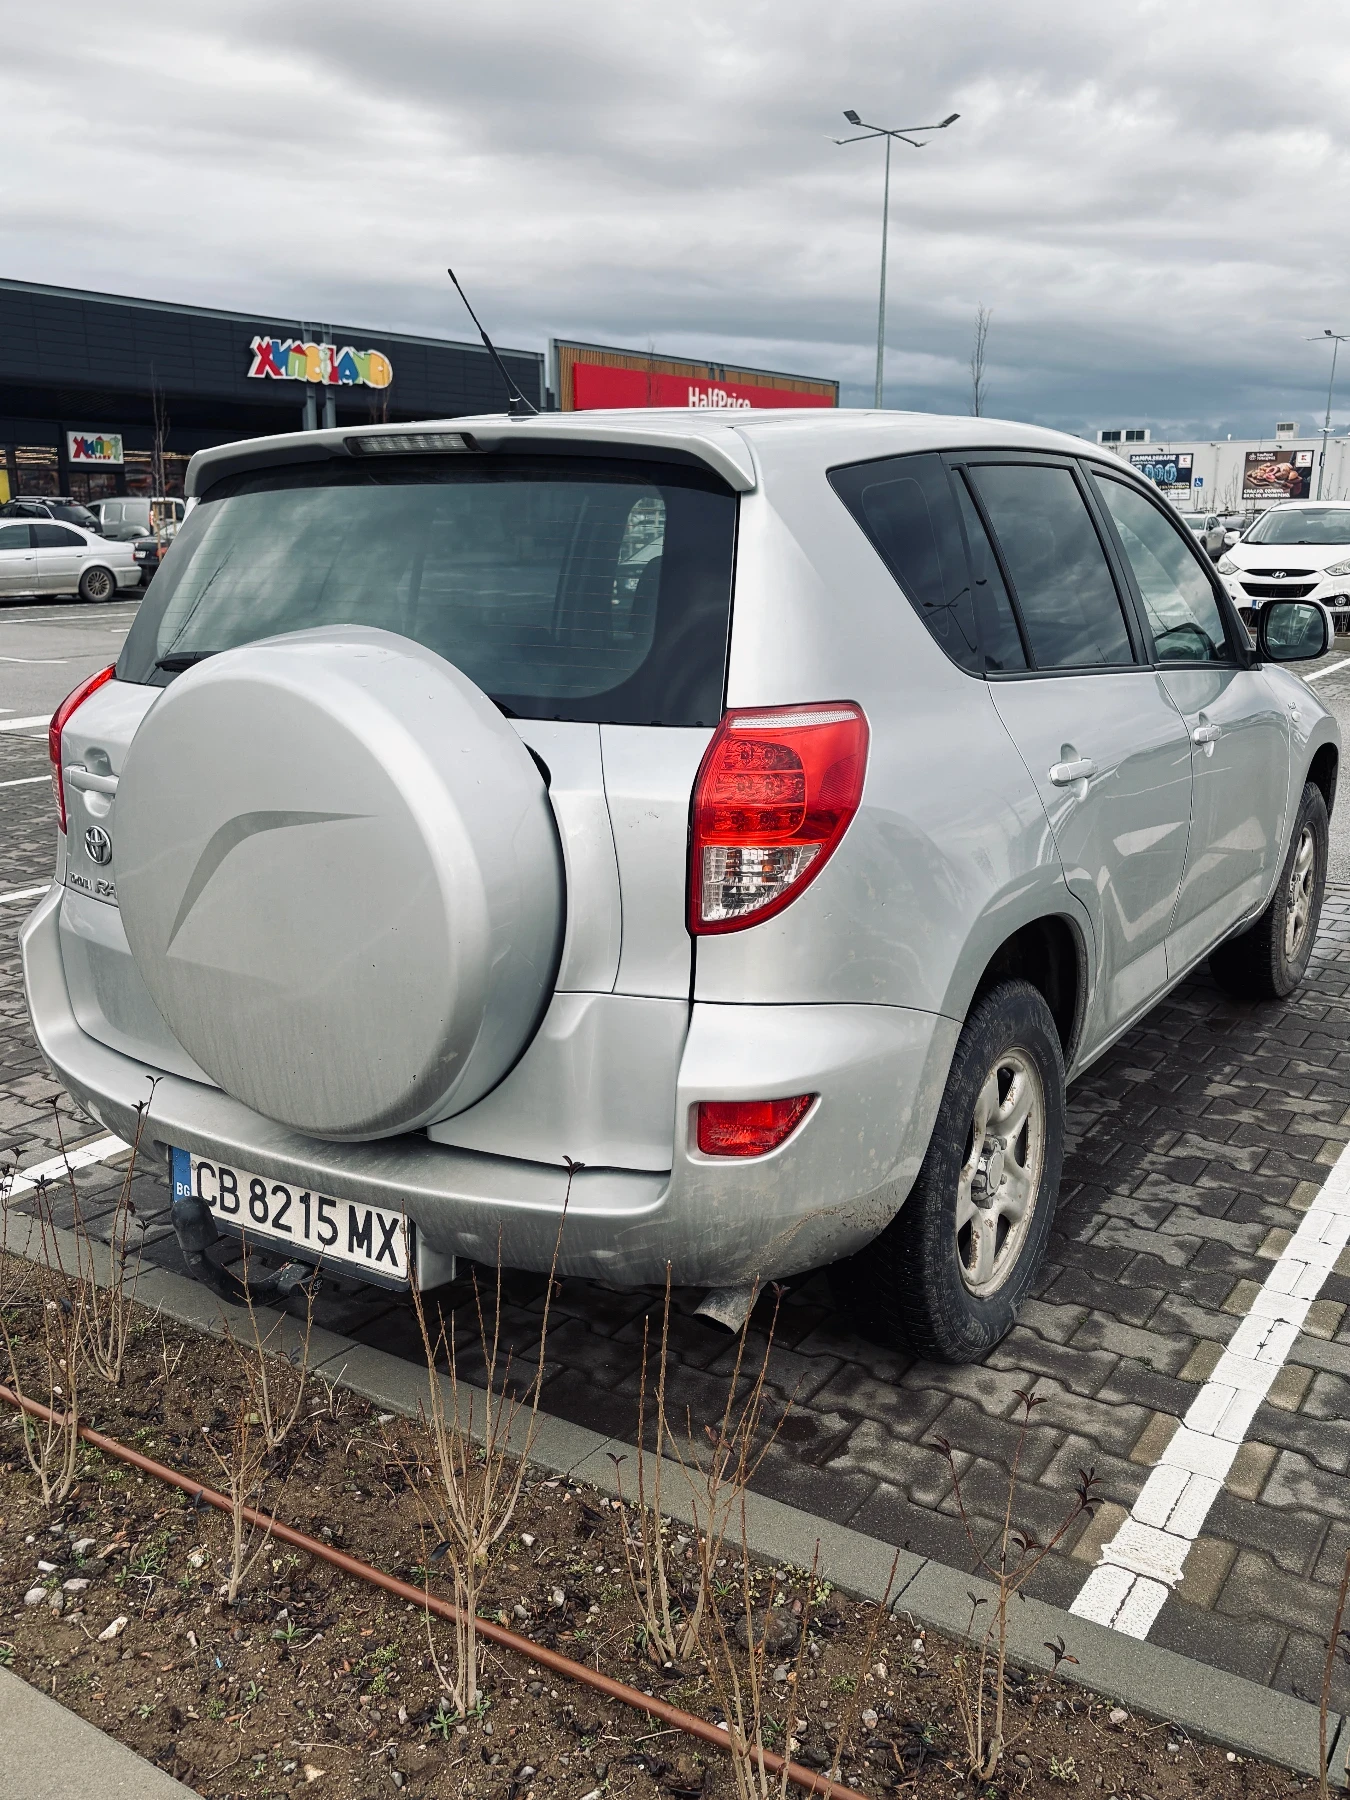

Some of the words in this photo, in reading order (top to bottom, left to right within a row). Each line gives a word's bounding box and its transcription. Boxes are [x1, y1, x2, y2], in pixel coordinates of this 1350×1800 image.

[688, 386, 751, 408] HalfPrice
[176, 1181, 190, 1197] BG
[197, 1161, 240, 1215] CB
[249, 1178, 339, 1246] 8215
[348, 1205, 399, 1267] MX
